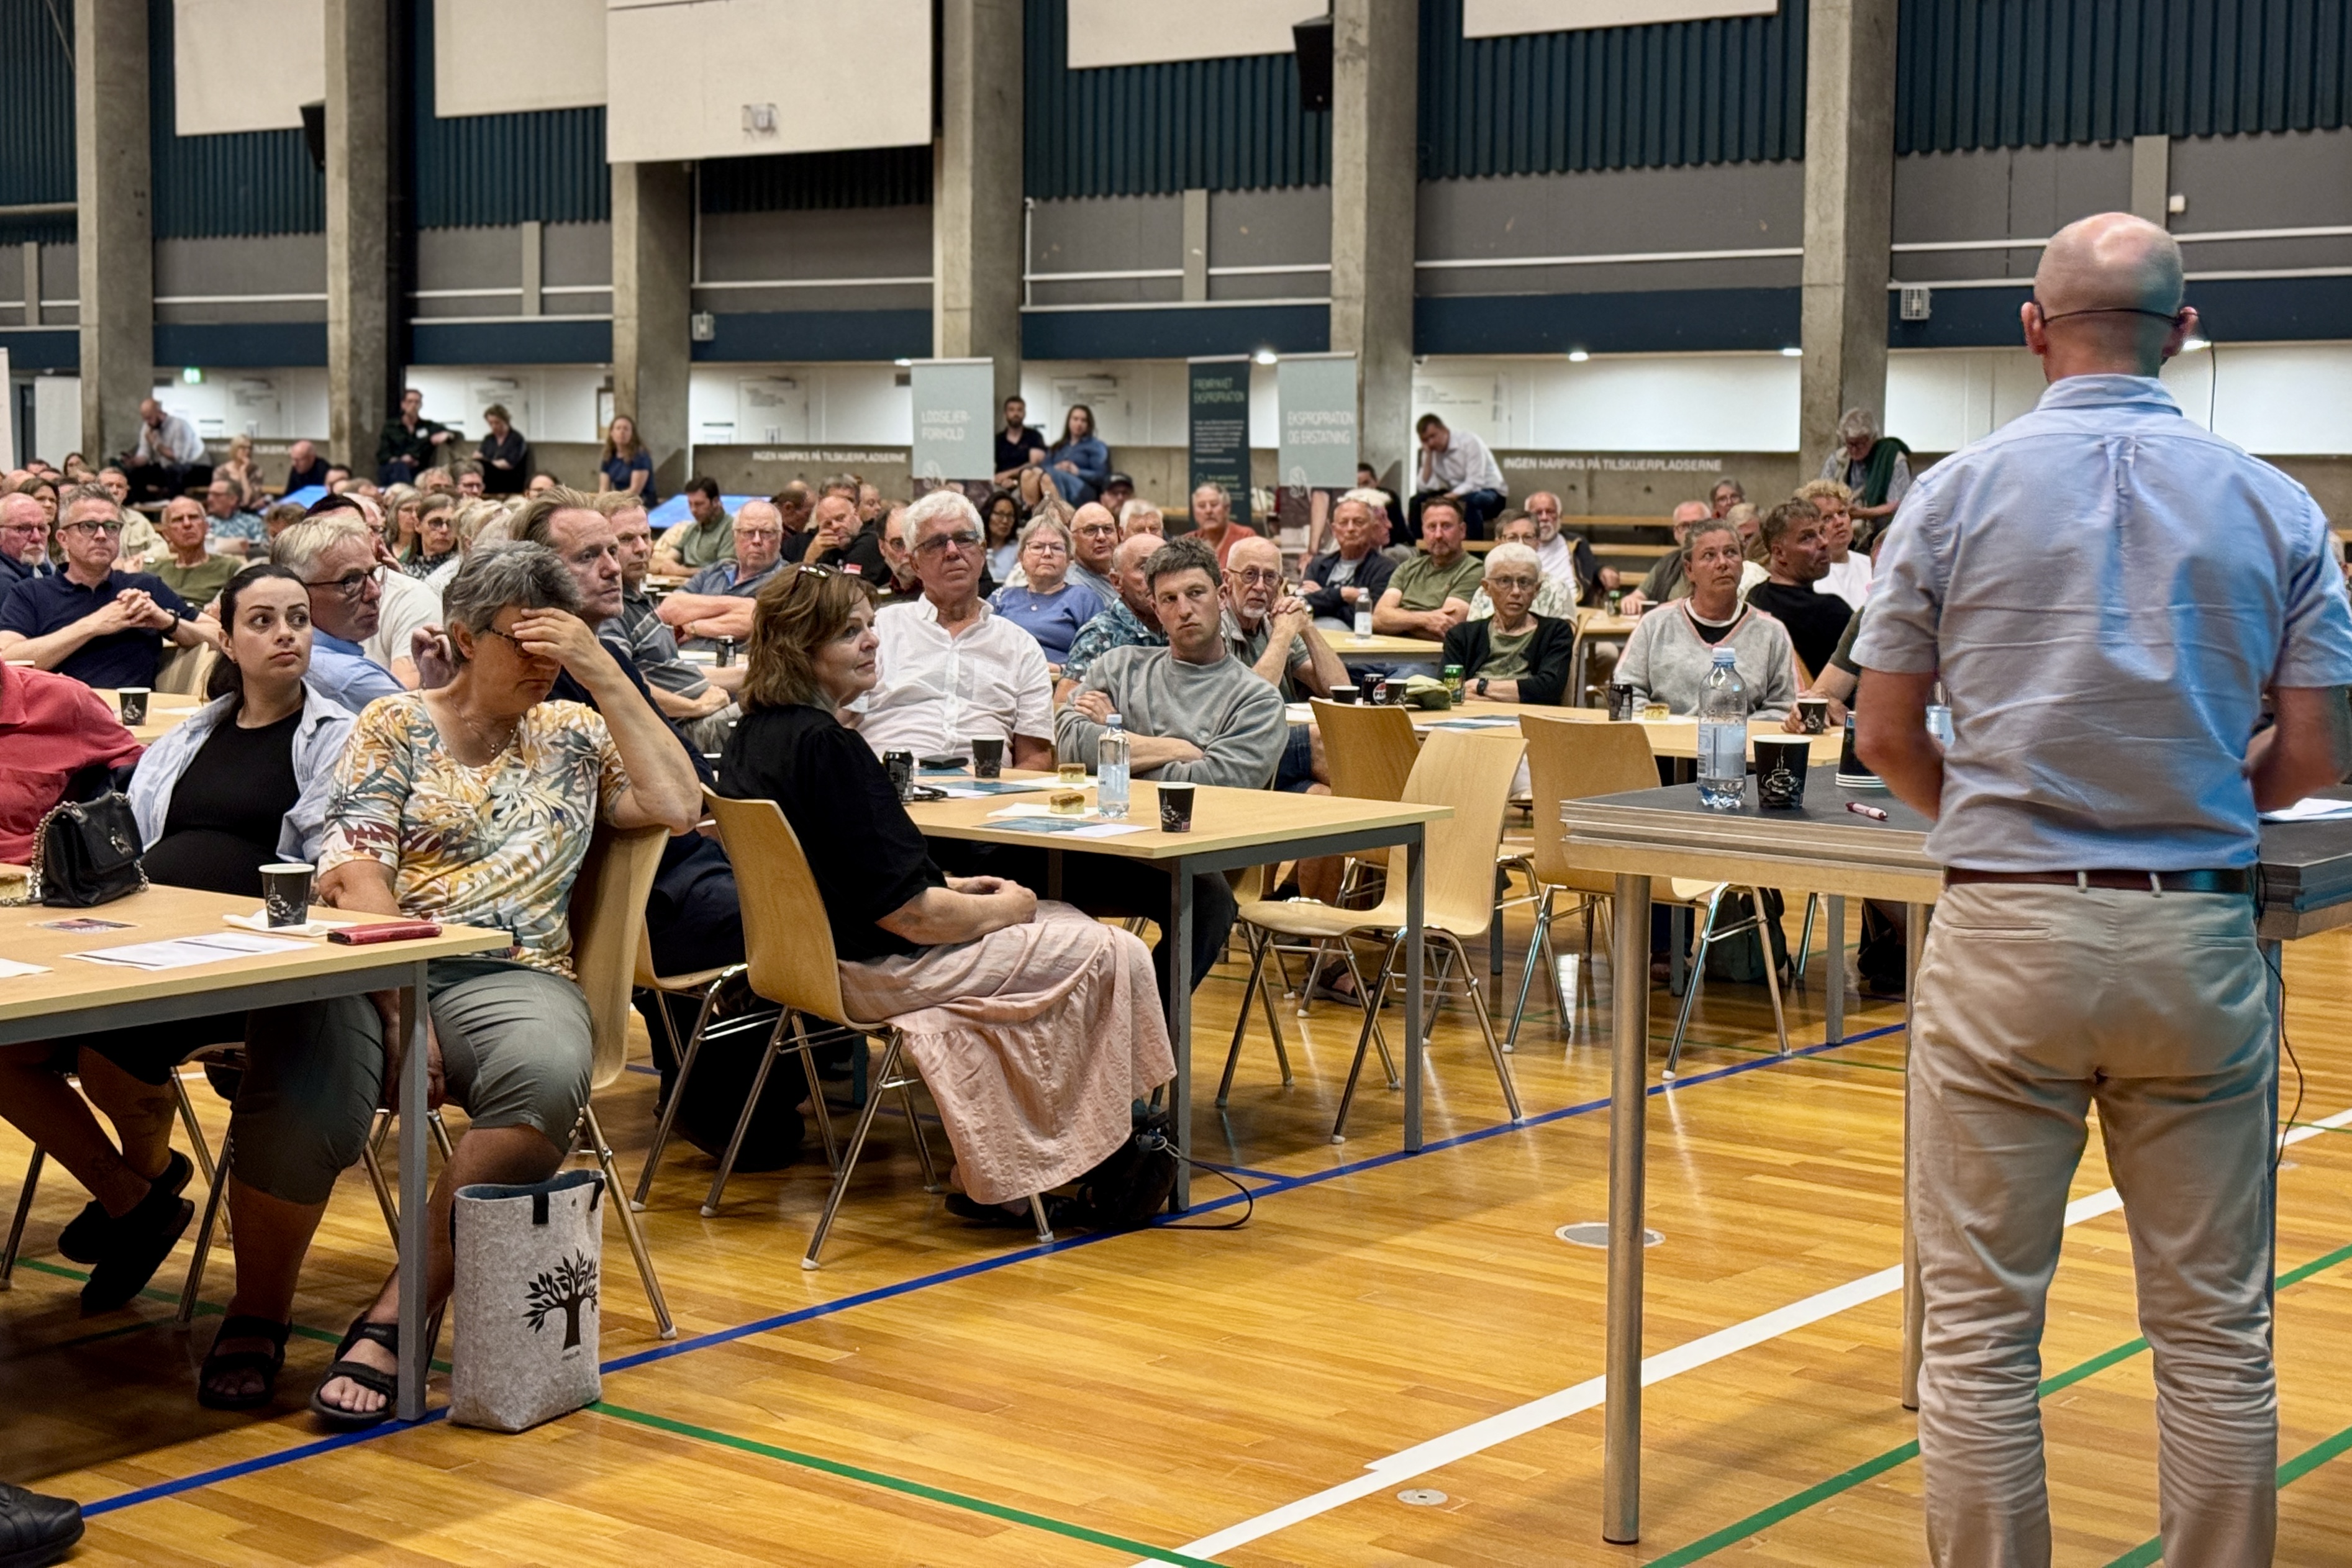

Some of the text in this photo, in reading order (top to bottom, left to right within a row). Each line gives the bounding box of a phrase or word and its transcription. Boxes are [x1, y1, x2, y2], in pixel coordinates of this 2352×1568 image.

[1287, 410, 1355, 425] EKSPROPRIATION
[922, 427, 965, 441] FORHOLD
[1287, 430, 1350, 445] OG ERSTATNING
[811, 448, 821, 461] PÅ
[1503, 456, 1722, 471] INGEN HARPIKS PÅ TILSKUERPLADSERNE
